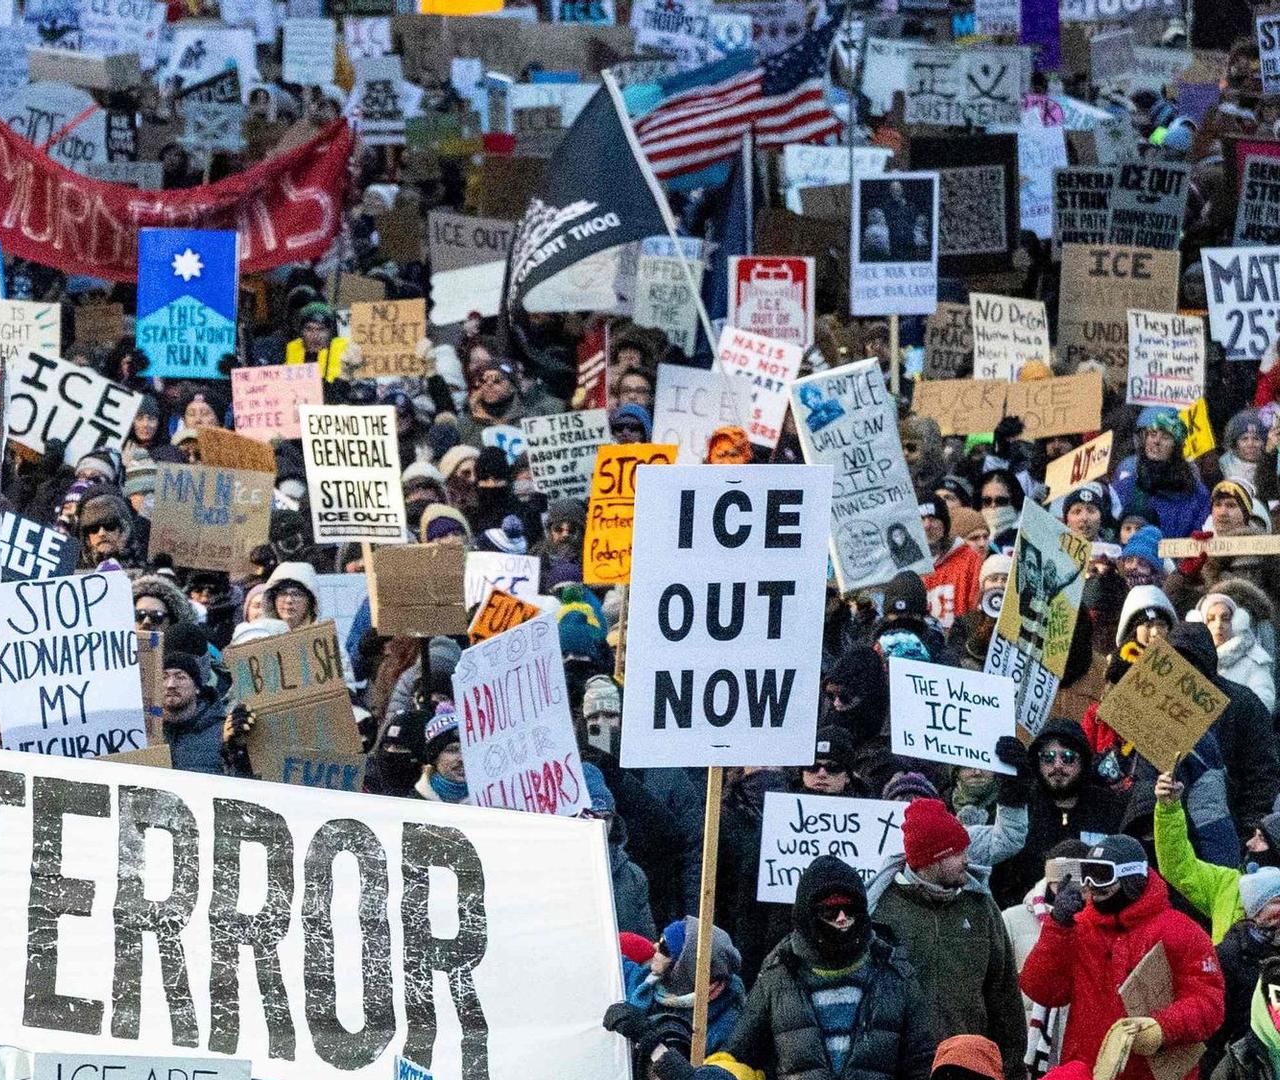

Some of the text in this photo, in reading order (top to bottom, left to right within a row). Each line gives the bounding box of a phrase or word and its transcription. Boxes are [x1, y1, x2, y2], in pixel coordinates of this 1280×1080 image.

[1088, 251, 1154, 280] ICE
[169, 303, 207, 329] THIS
[1132, 313, 1169, 337] They
[142, 326, 187, 347] STATE
[356, 322, 424, 346] SECRET
[731, 334, 786, 361] NAZIS
[164, 343, 207, 368] RUN
[21, 352, 136, 426] ICE
[307, 414, 388, 437] EXPAND THE
[548, 413, 585, 431] THIS
[558, 426, 605, 445] REALLY
[313, 438, 392, 469] GENERAL
[321, 479, 390, 511] STRIKE!
[677, 489, 803, 549] ICE
[7, 574, 109, 636] STOP
[657, 580, 795, 642] OUT
[39, 681, 90, 729] MY
[653, 668, 797, 728] NOW
[905, 673, 1000, 710] THE WRONG
[1175, 671, 1220, 714] KINGS
[925, 701, 973, 737] ICE
[789, 798, 861, 835] Jesus
[777, 838, 858, 857] was an
